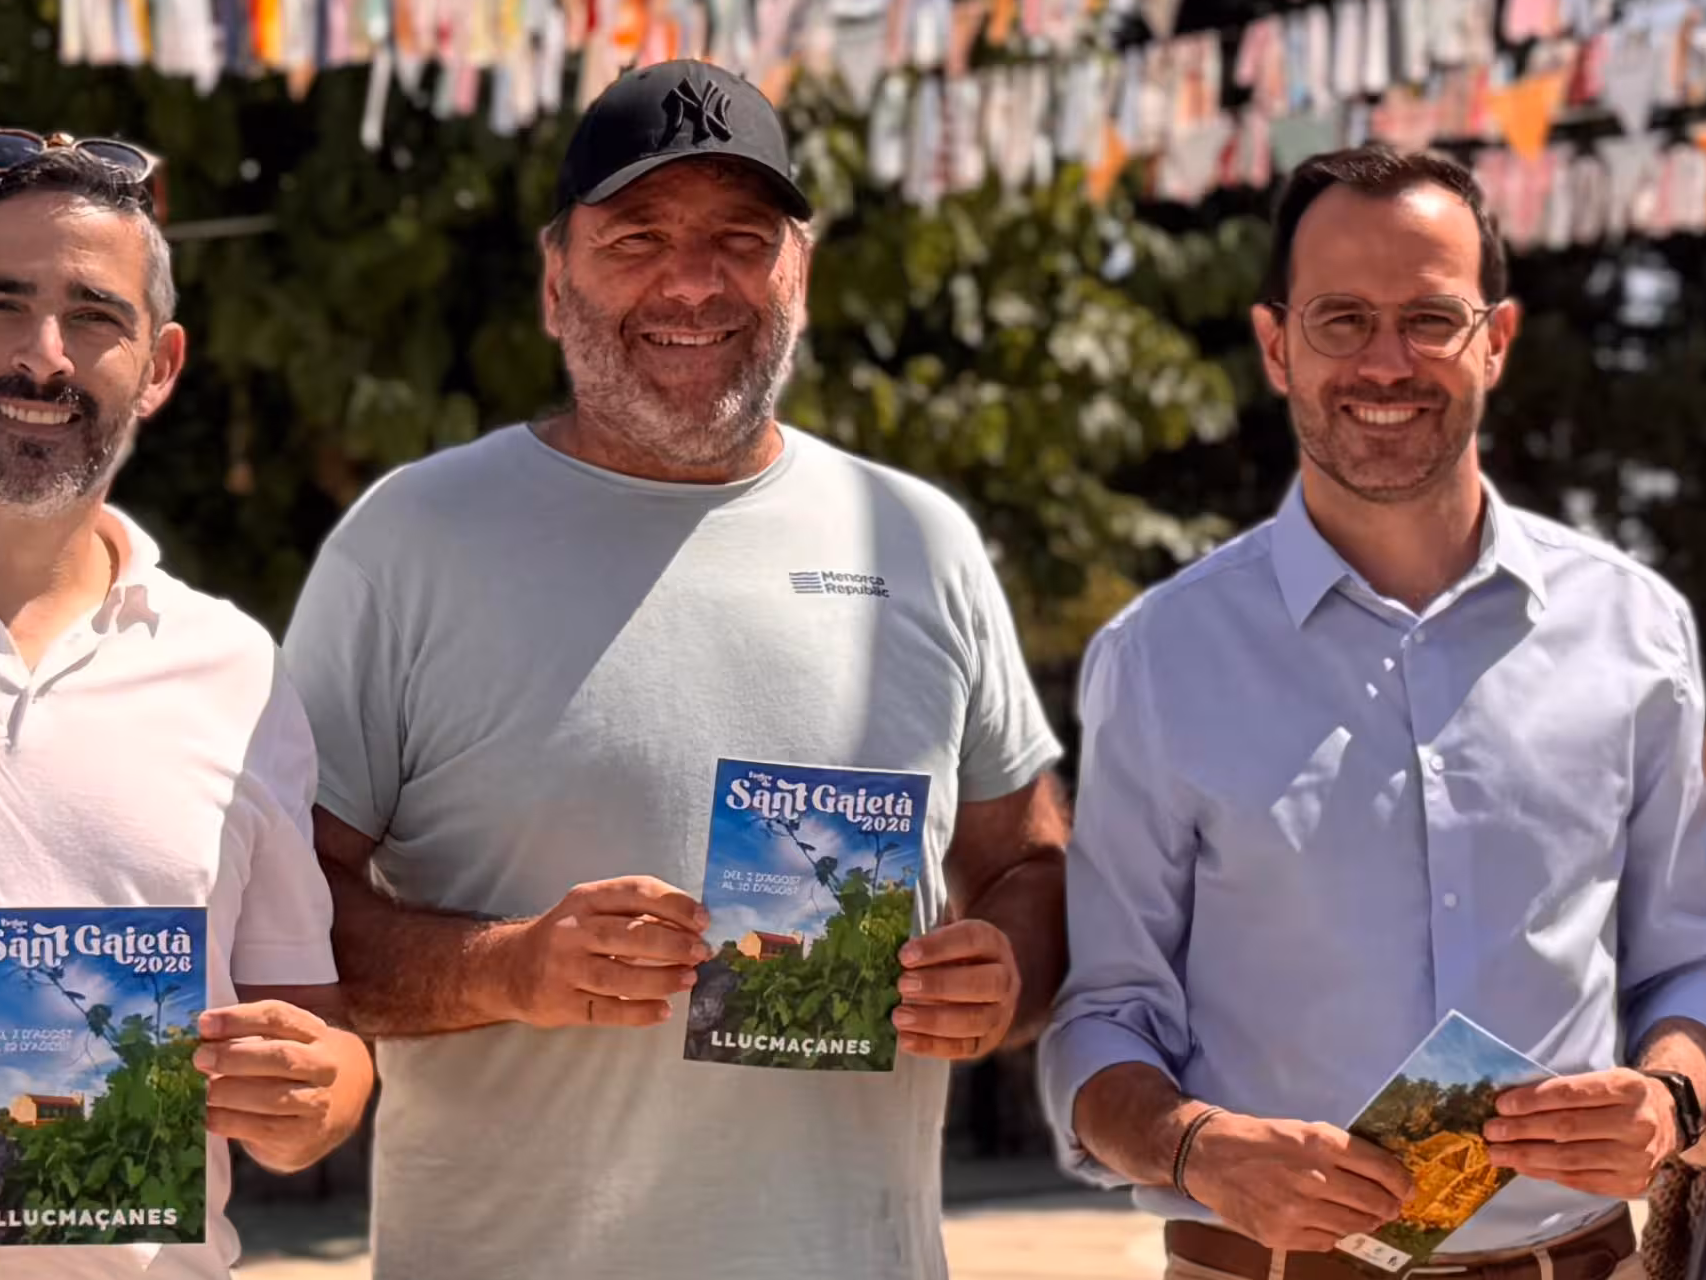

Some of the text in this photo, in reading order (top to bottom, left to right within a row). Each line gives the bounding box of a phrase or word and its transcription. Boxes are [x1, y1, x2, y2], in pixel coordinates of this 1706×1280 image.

[657, 77, 733, 152] NY
[820, 570, 885, 586] Menorca
[824, 582, 890, 599] Republic
[726, 778, 808, 819] Sant
[812, 784, 913, 823] Gaietà
[74, 925, 191, 965] Gaietà
[134, 956, 192, 973] 2026
[711, 1031, 871, 1057] LLUCMAÇANES
